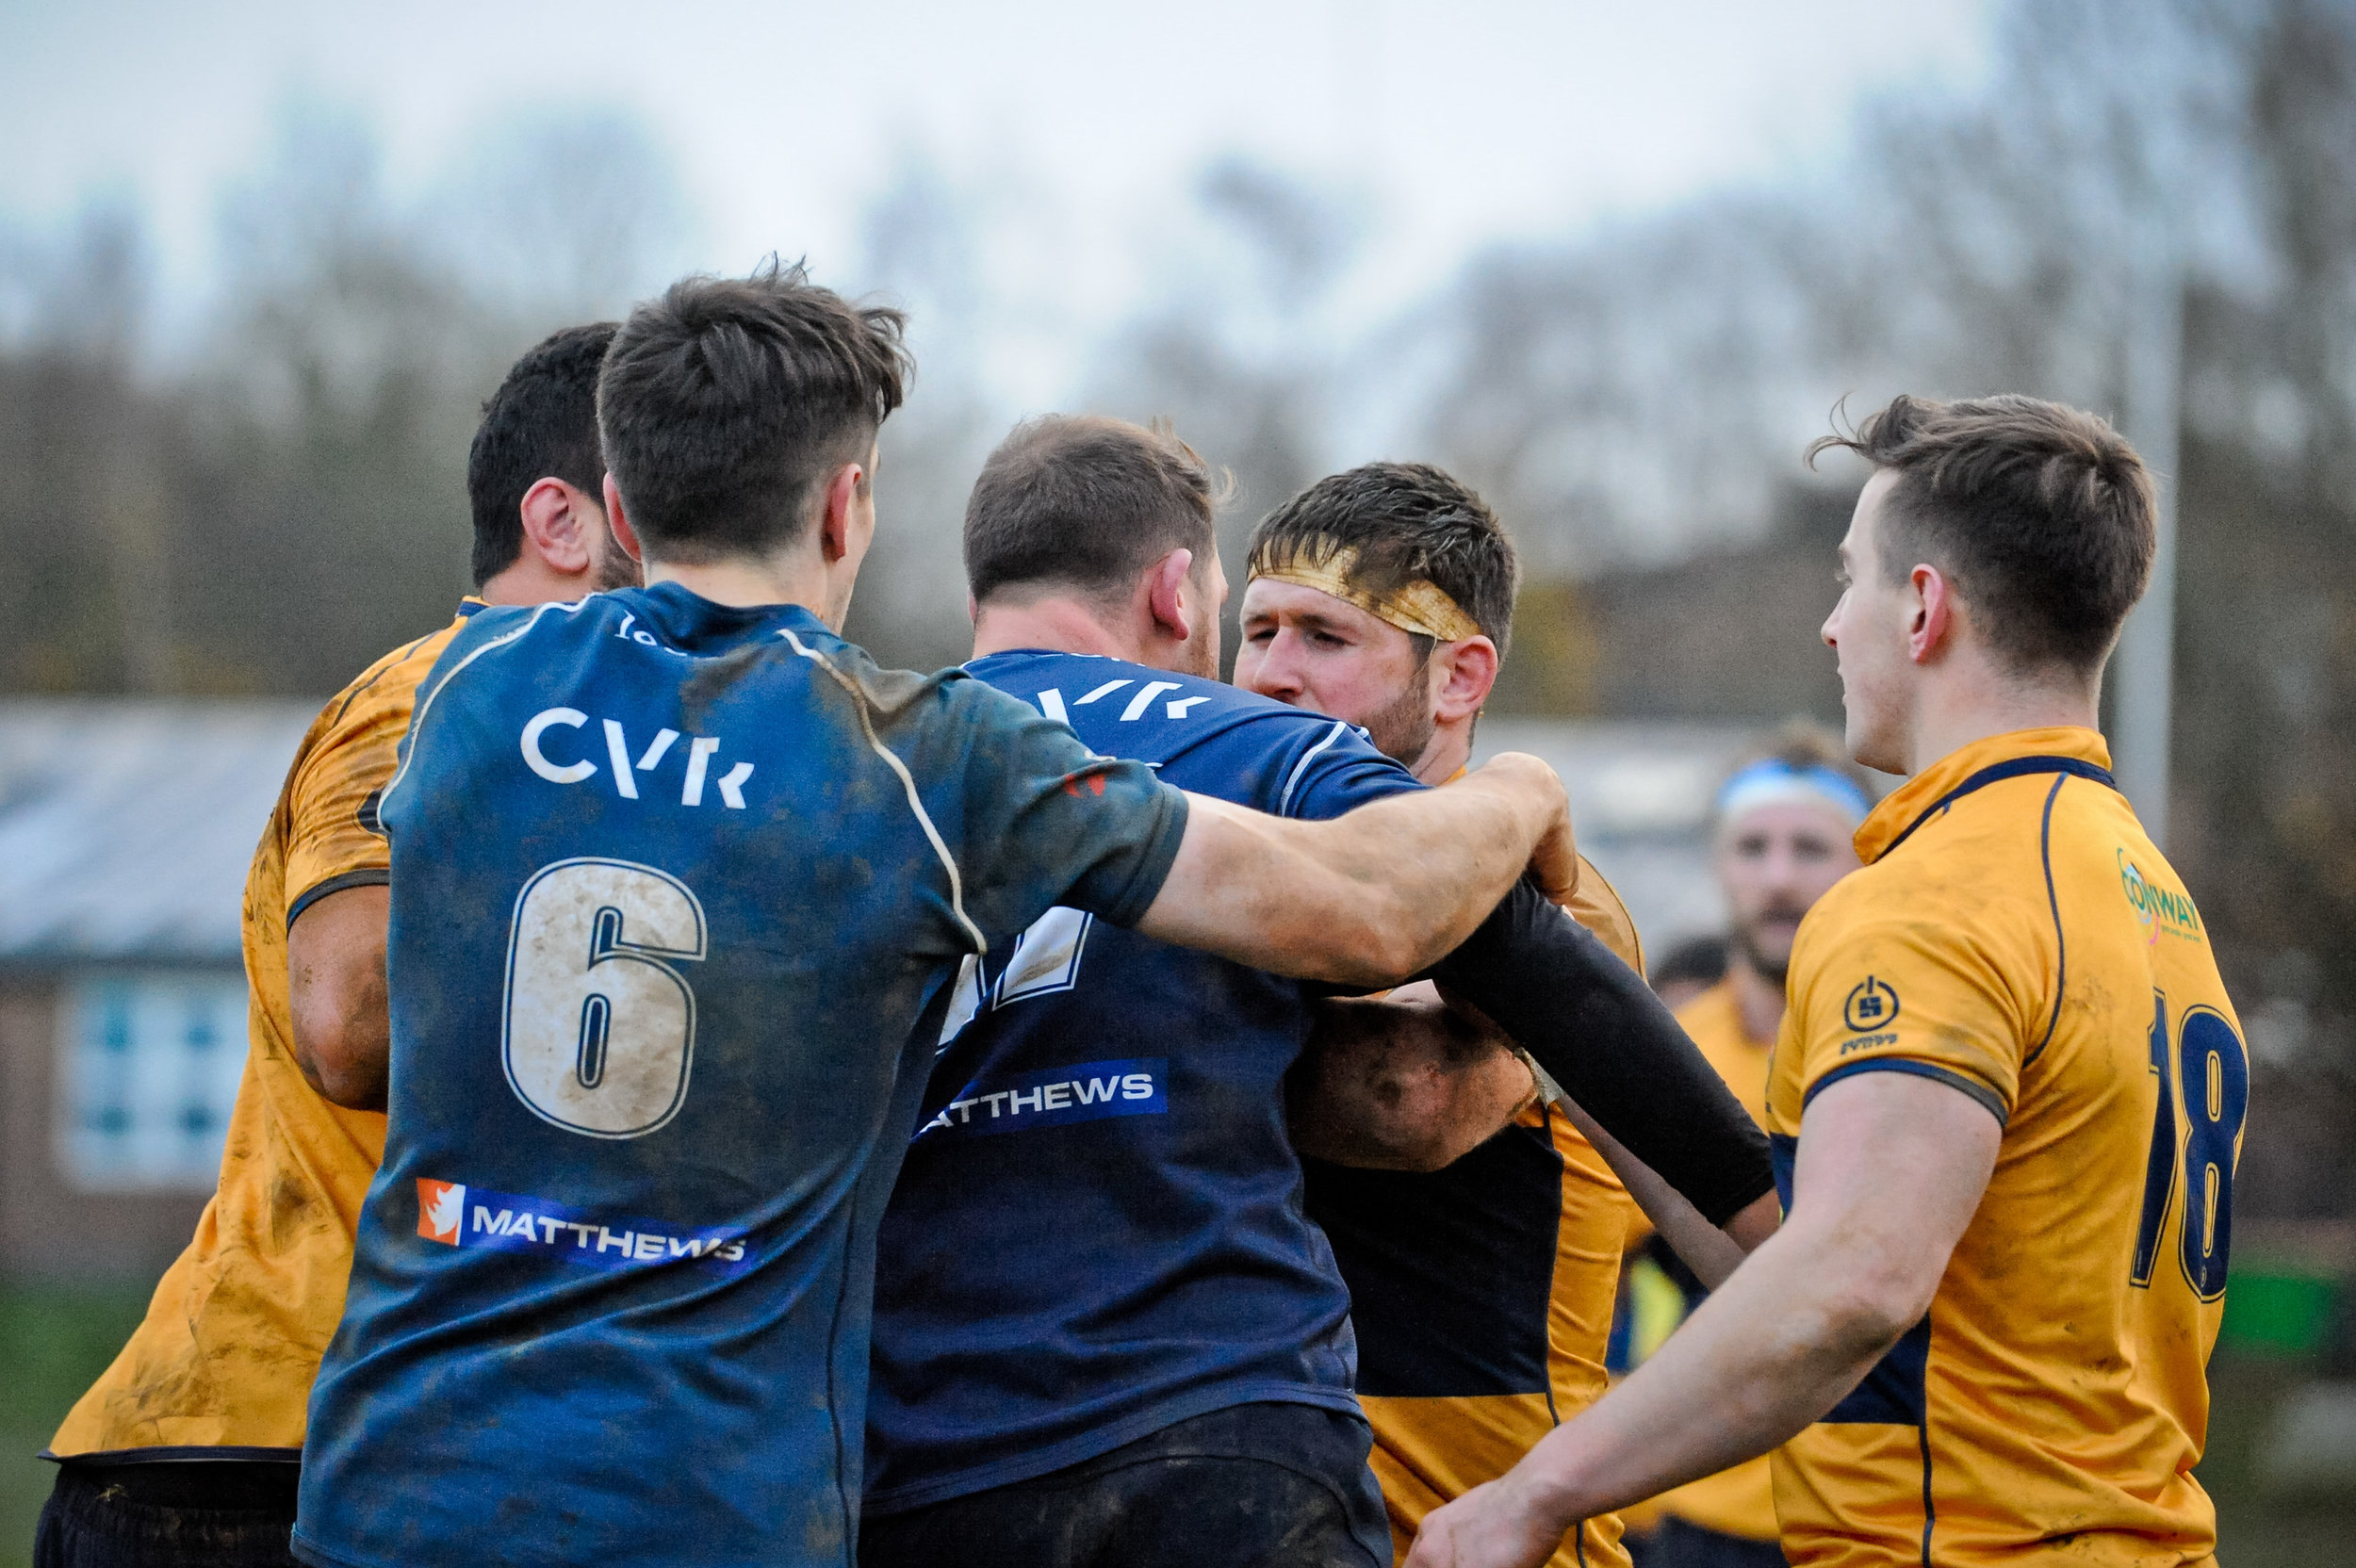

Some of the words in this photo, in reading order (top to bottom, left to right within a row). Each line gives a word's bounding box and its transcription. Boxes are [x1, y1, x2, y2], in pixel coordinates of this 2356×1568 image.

[1038, 679, 1212, 728] VR
[2117, 847, 2199, 931] CONWAY
[501, 857, 708, 1140] 6
[919, 1073, 1154, 1133] ATTHEWS
[2129, 986, 2250, 1304] 18
[472, 1205, 746, 1262] MATTHEWS
